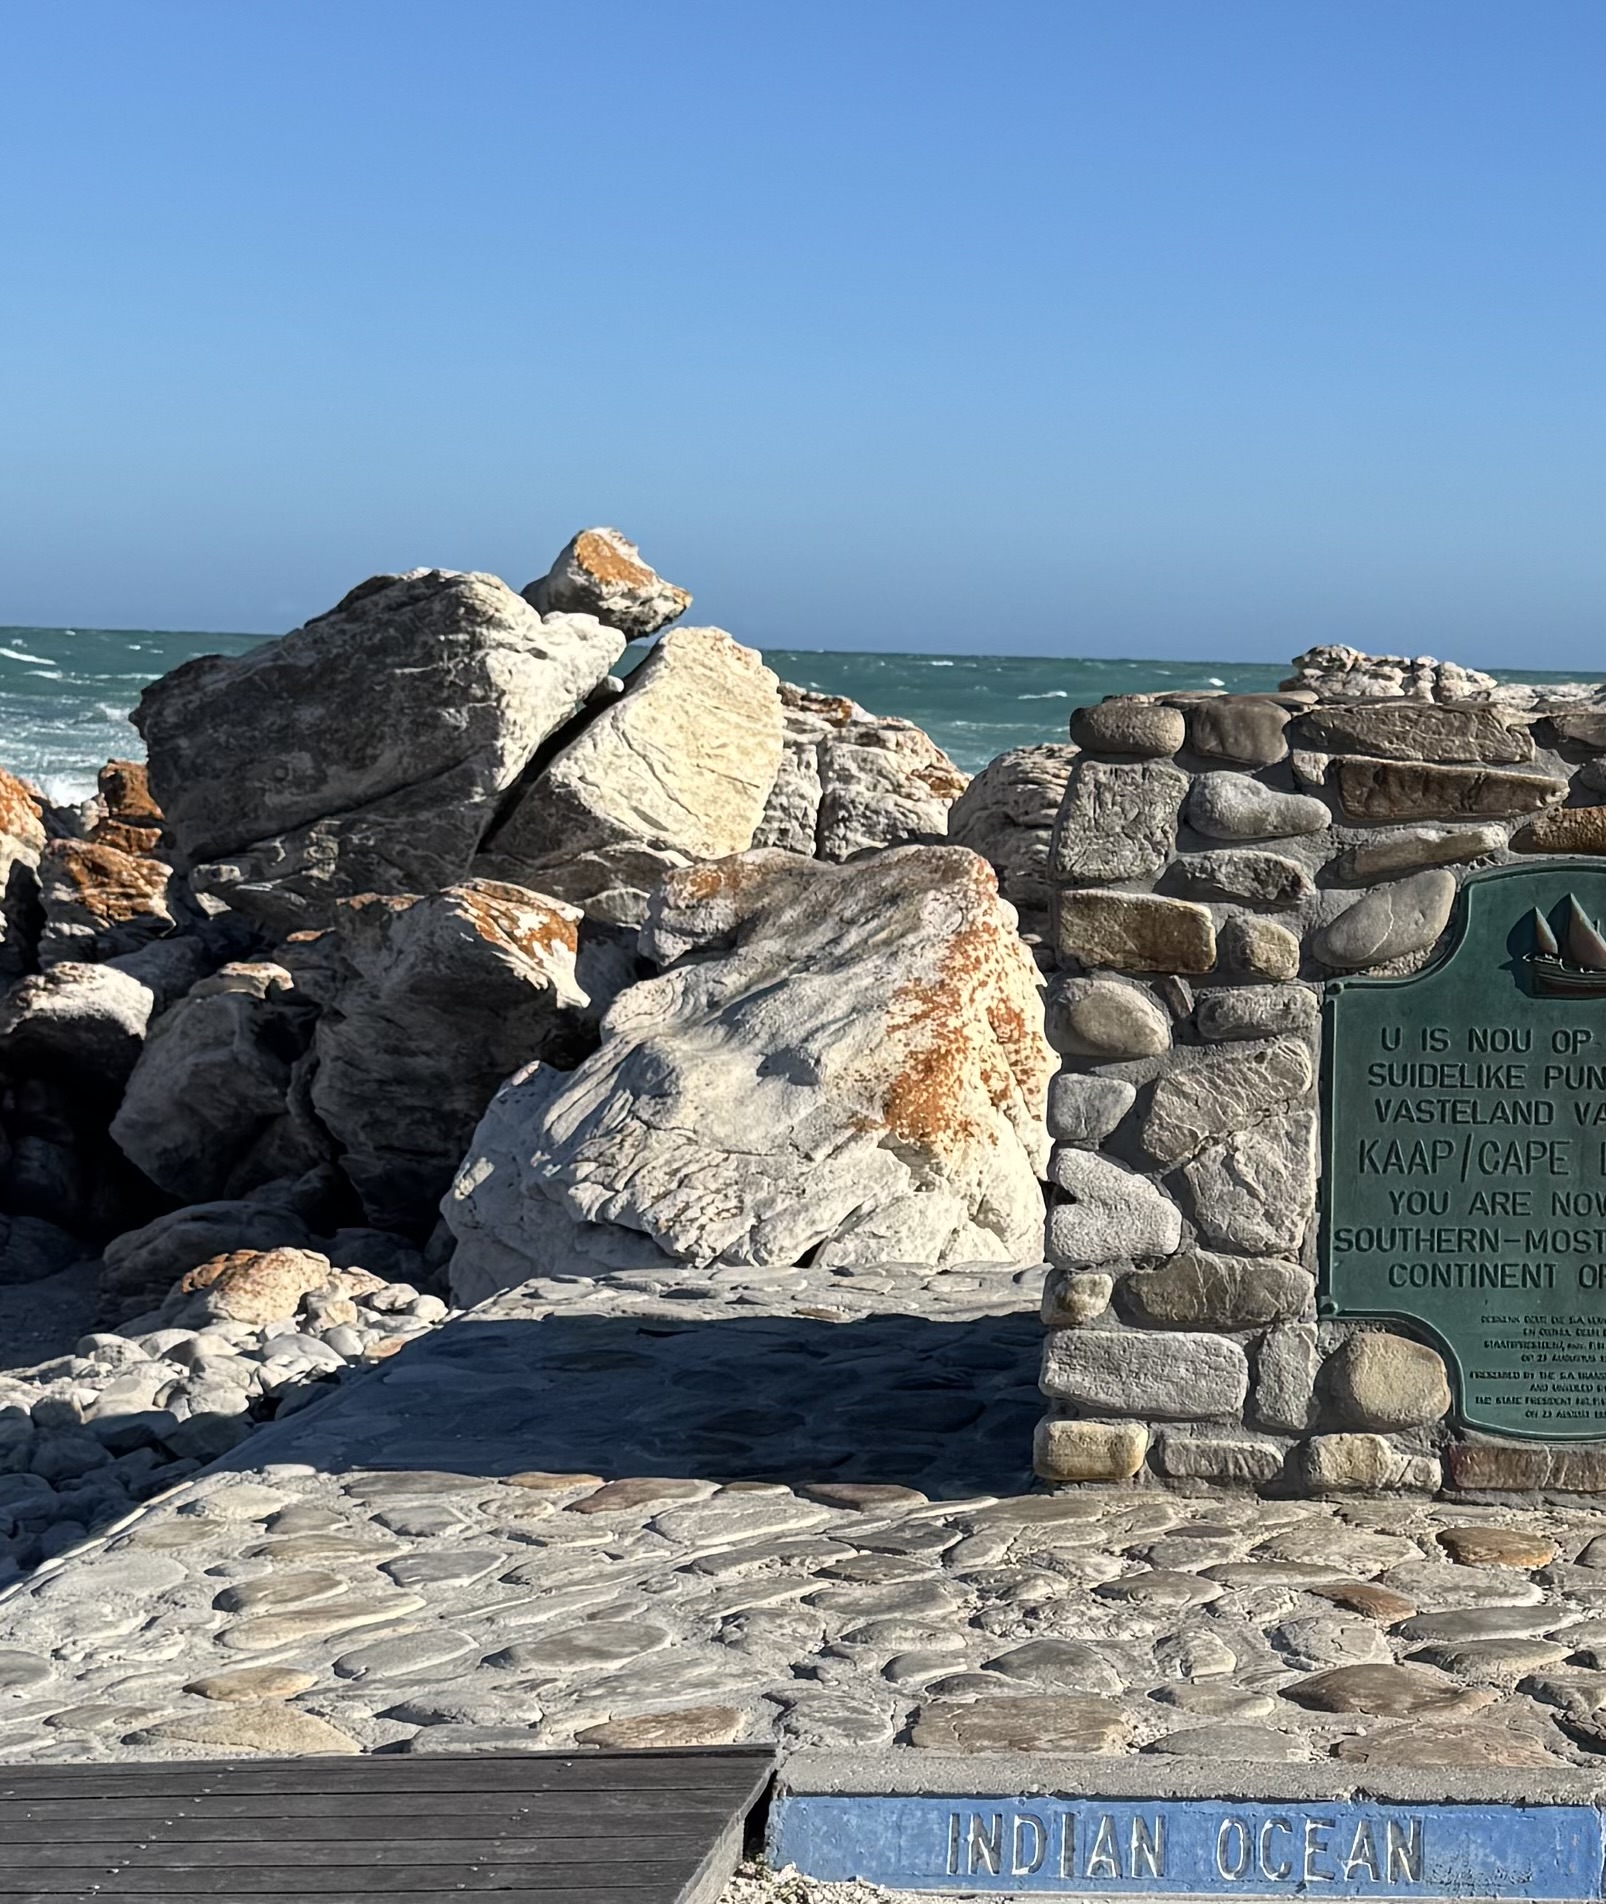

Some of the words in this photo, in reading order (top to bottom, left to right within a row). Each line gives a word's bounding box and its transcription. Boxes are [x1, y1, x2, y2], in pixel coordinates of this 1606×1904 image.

[1382, 1027, 1402, 1052] U
[1422, 1027, 1451, 1053] IS
[1468, 1027, 1532, 1053] NOU
[1552, 1029, 1593, 1055] OP
[1367, 1062, 1527, 1090] SUIDELIKE
[1374, 1098, 1555, 1126] VASTELAND
[1359, 1133, 1573, 1183] KAAP/CAPE
[1388, 1190, 1450, 1216] YOU
[1468, 1191, 1532, 1217] ARE
[1388, 1263, 1558, 1289] CONTINENT
[946, 1812, 1166, 1879] INDIAN
[1216, 1816, 1422, 1884] OCEAN
